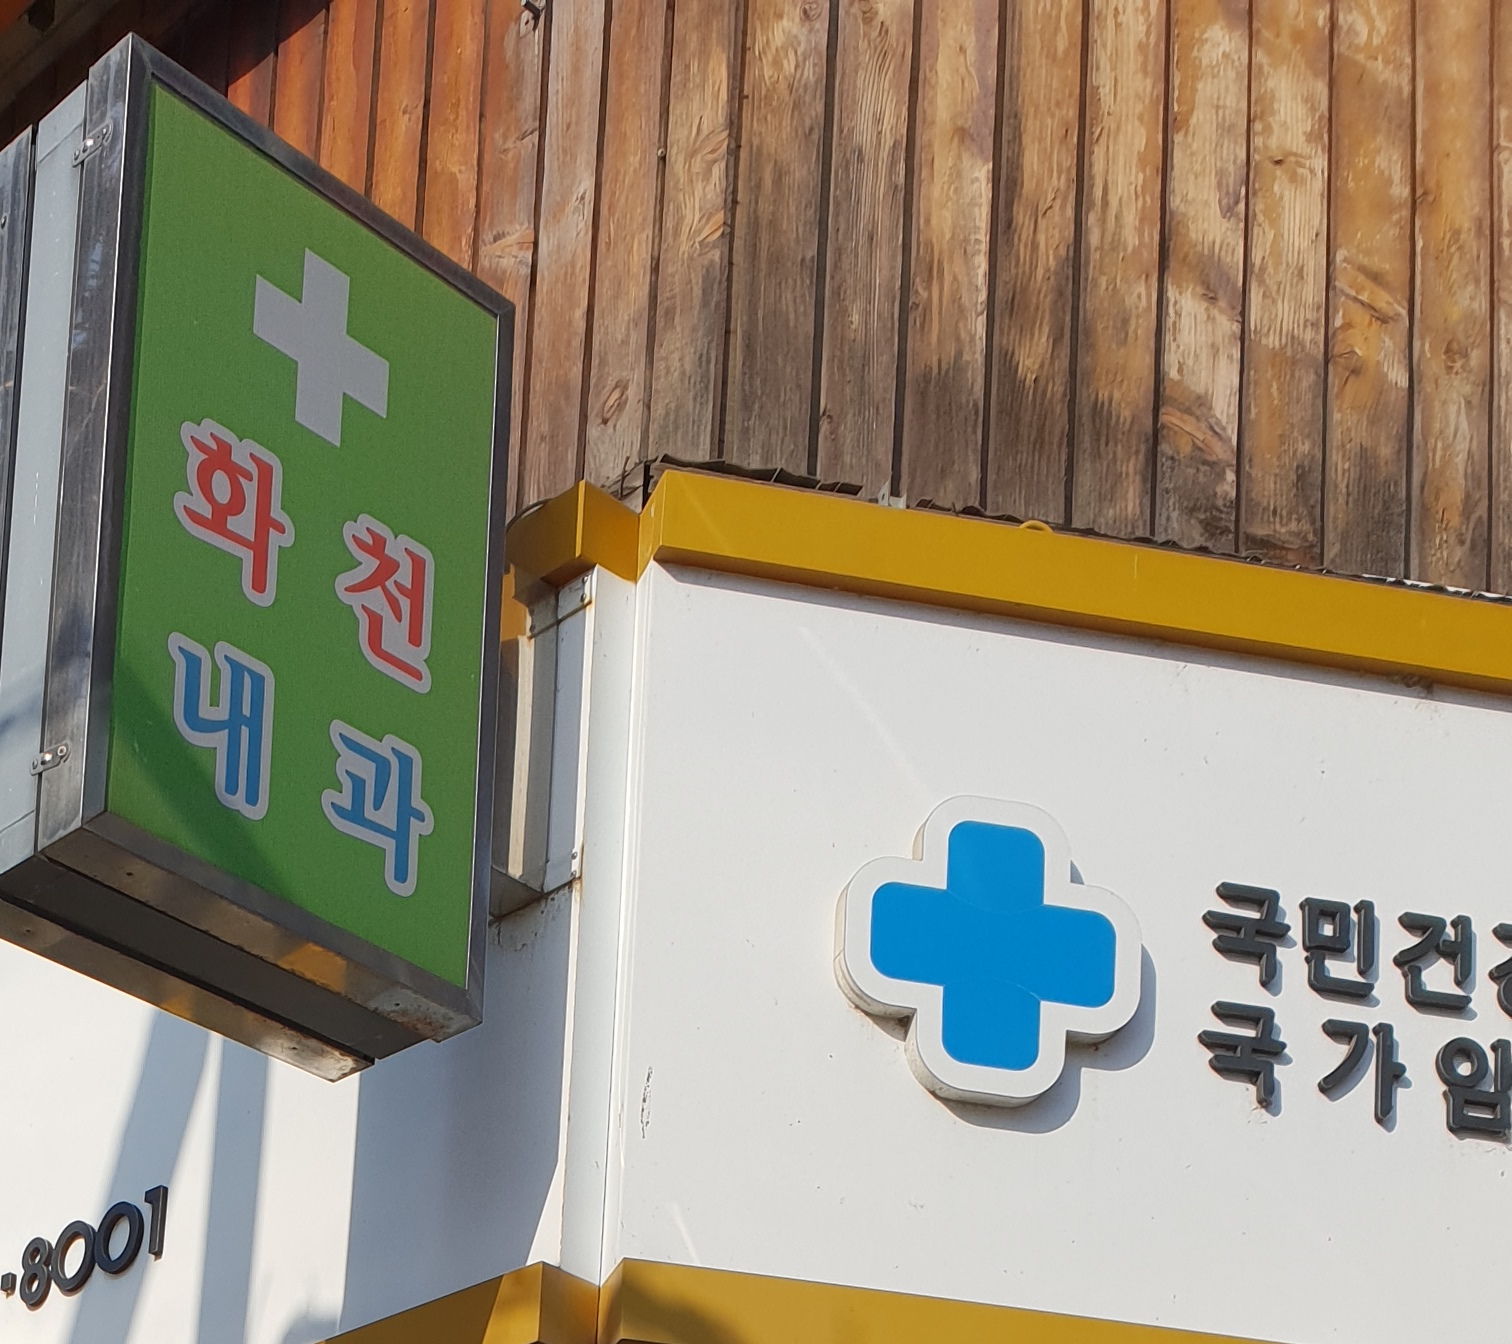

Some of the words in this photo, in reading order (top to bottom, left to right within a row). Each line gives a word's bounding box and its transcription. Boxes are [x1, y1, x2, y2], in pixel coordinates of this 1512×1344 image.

[180, 426, 428, 686] 화천
[175, 640, 426, 890] 내과
[1201, 881, 1512, 1018] 국민건
